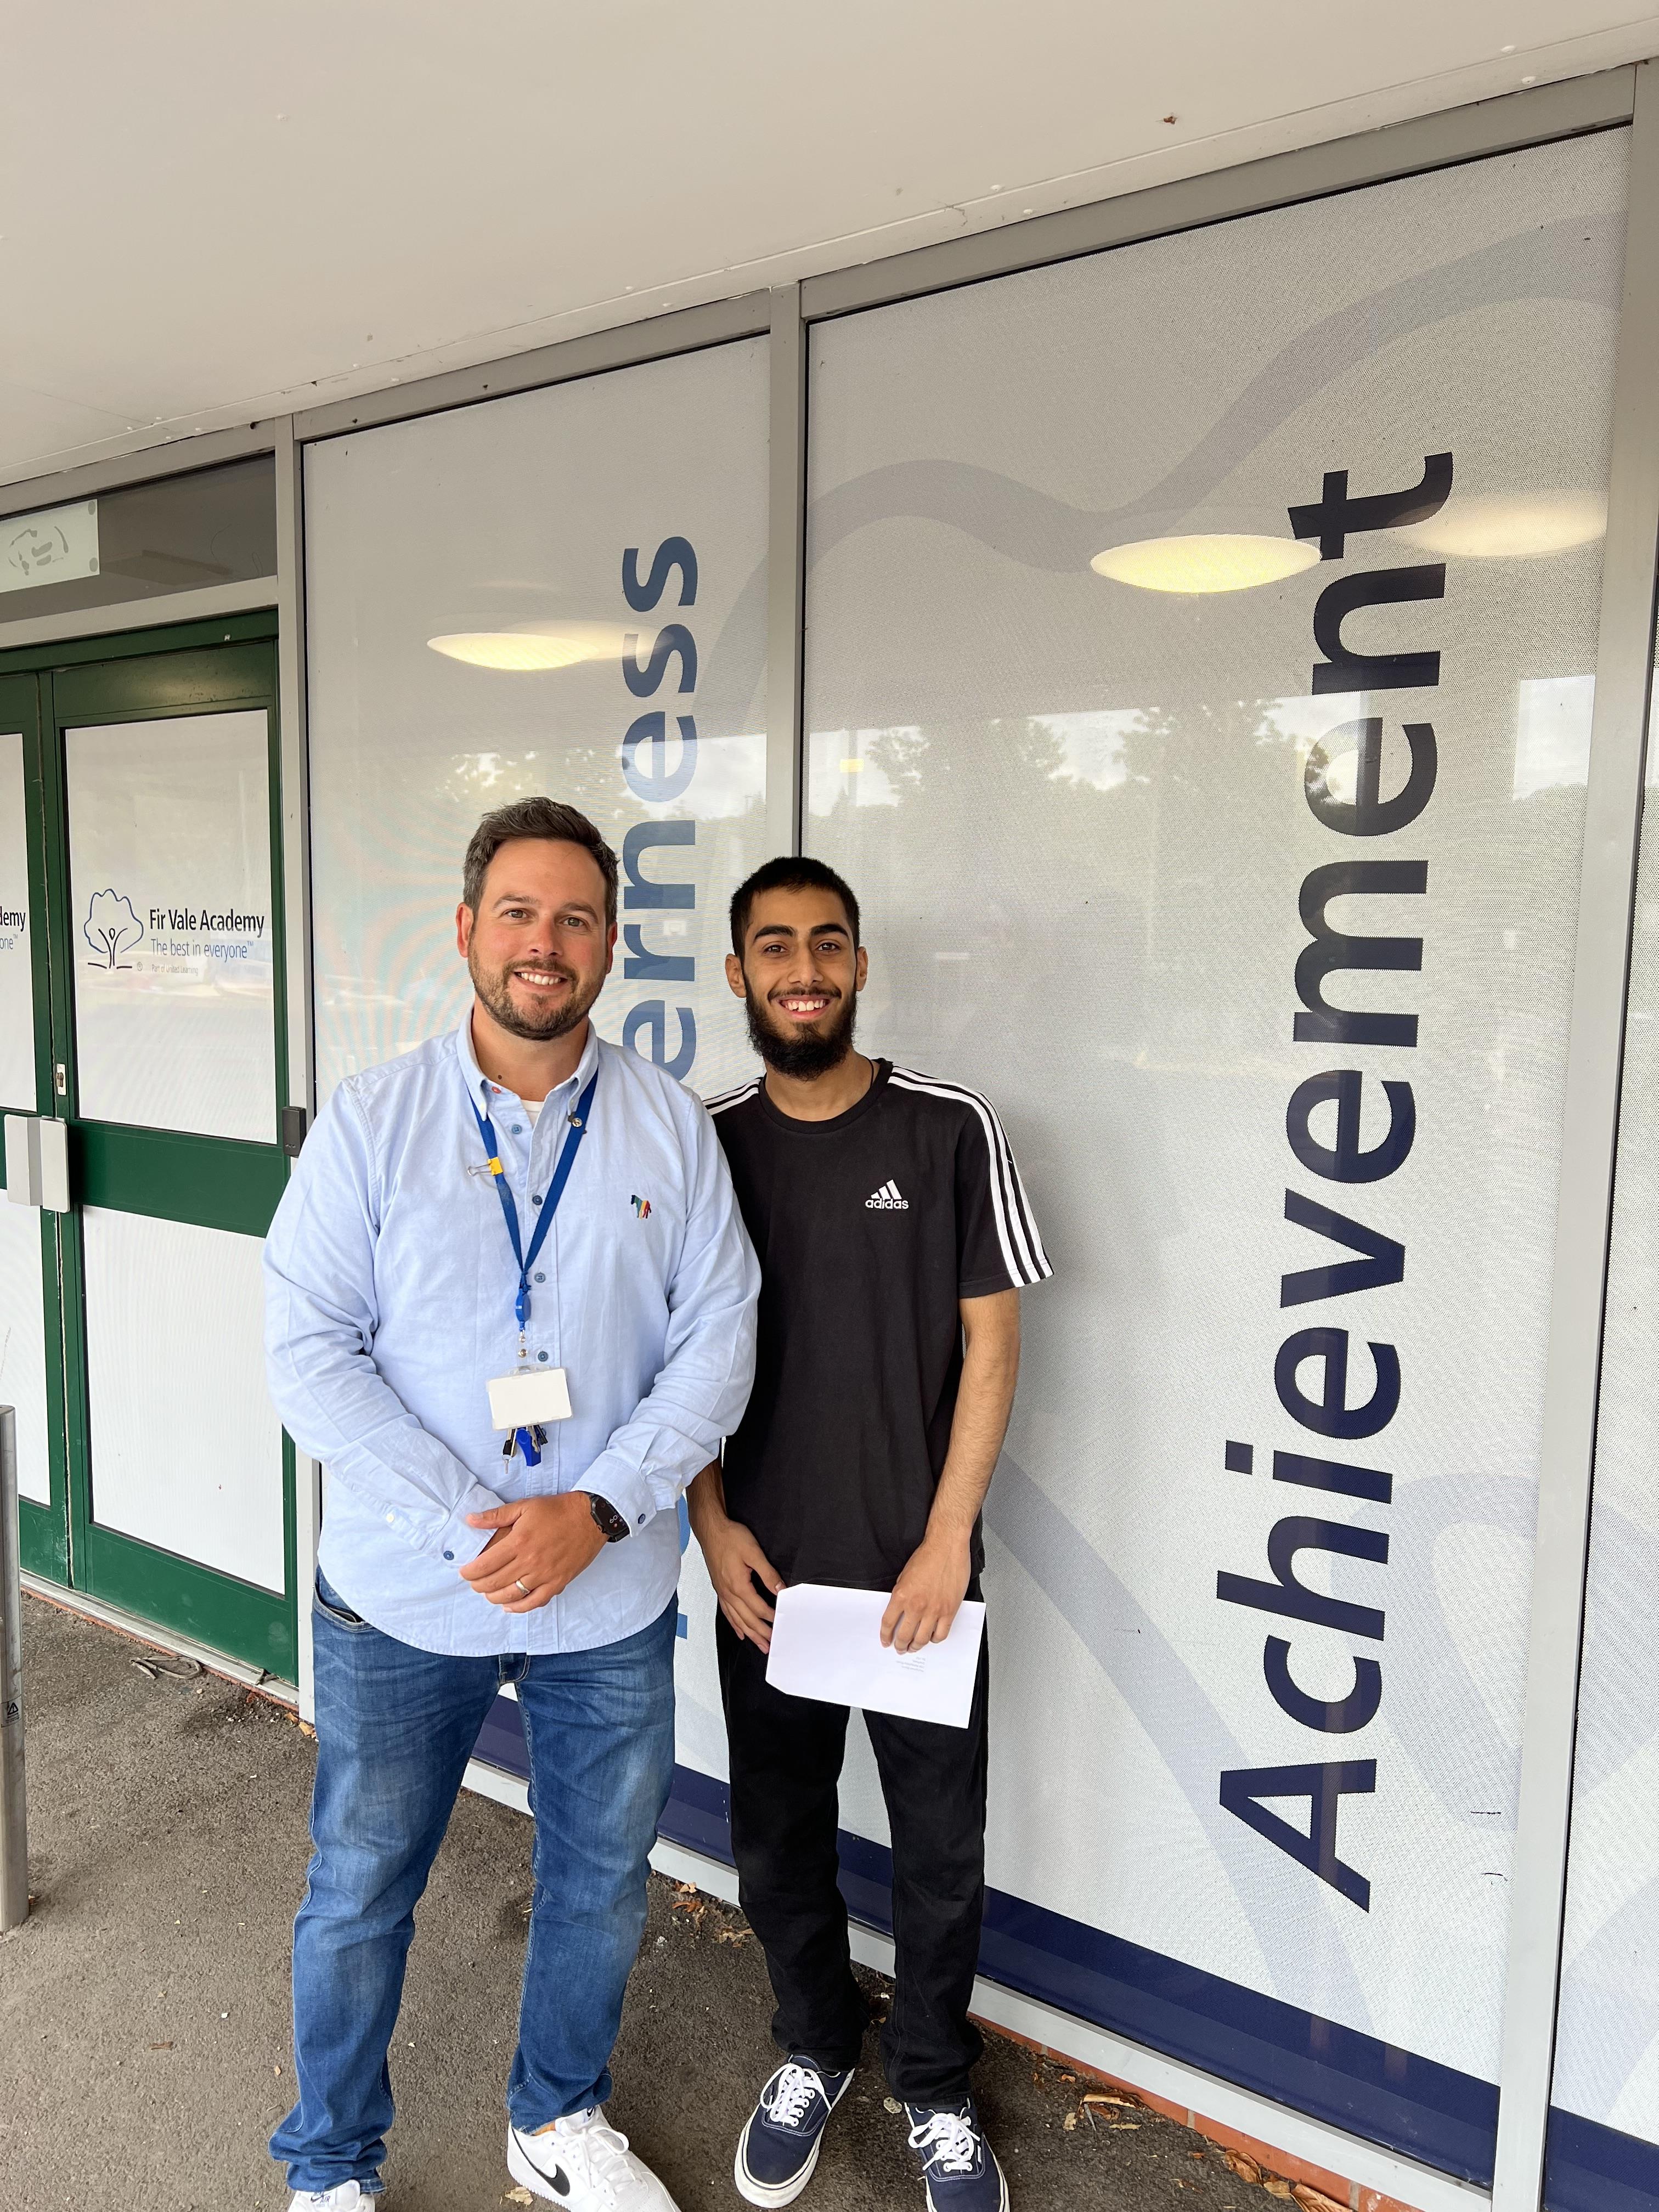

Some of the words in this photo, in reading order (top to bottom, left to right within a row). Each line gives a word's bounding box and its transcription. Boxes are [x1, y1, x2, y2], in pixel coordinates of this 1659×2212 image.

[622, 536, 698, 1084] erness
[150, 908, 165, 930] Fir
[168, 908, 196, 930] Vale
[200, 909, 264, 938] Academy
[151, 938, 167, 956] The
[171, 938, 189, 956] best
[193, 940, 201, 957] in
[1216, 452, 1453, 1913] Achievement
[865, 1198, 909, 1209] adidas
